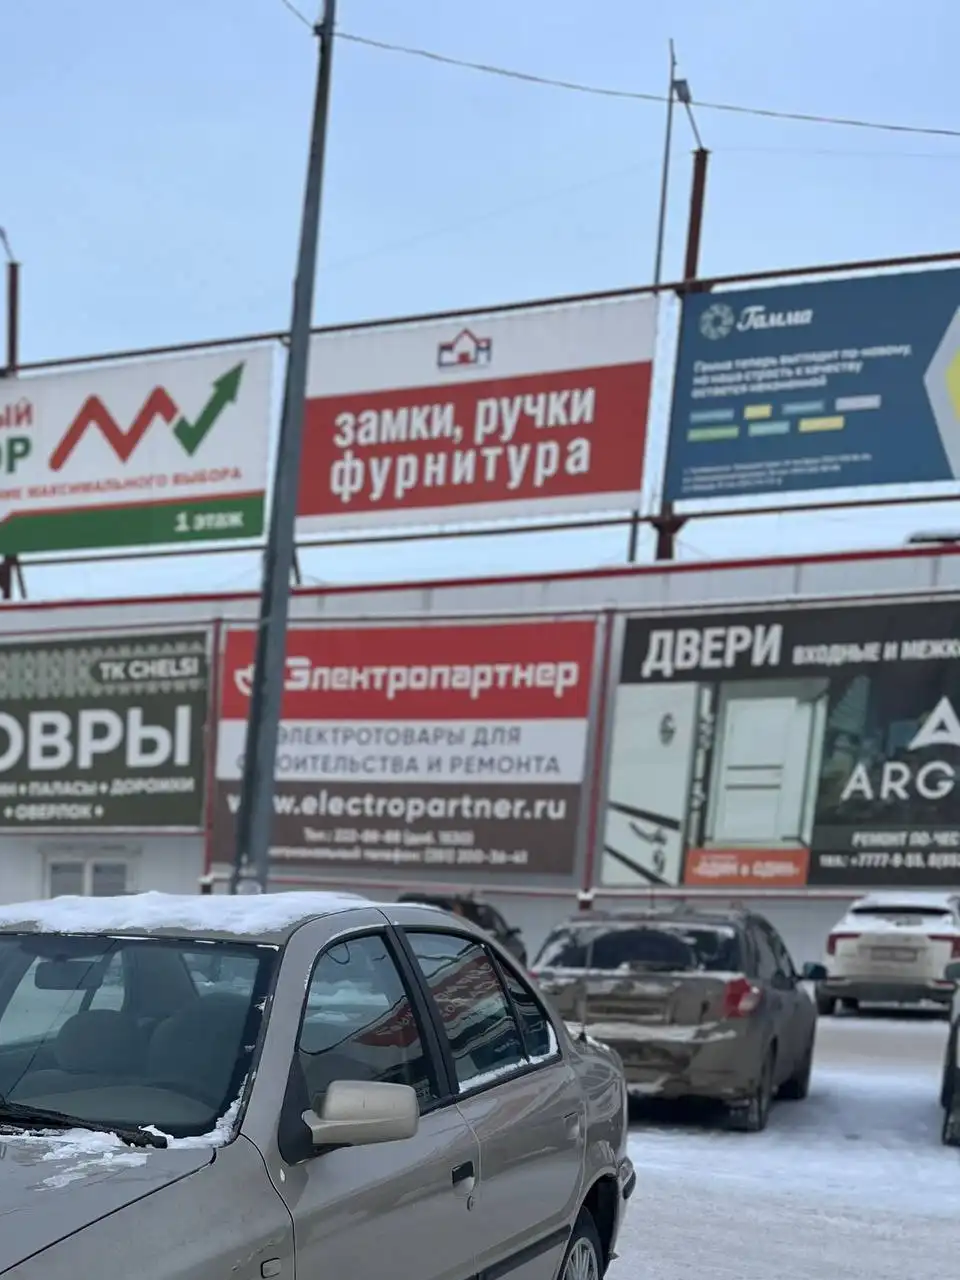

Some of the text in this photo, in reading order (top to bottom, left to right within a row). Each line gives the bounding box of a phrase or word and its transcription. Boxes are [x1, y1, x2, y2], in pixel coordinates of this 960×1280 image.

[737, 305, 813, 332] Гамма
[333, 387, 596, 448] замки, ручки
[27, 473, 168, 499] МАКСИМАЛЬНОГО
[172, 466, 243, 487] ВЫБОРА
[330, 437, 592, 504] фурнитура
[174, 511, 190, 532] 1
[642, 623, 783, 678] ДВЕРИ
[128, 656, 200, 680] CHELSI
[471, 725, 521, 749] ДЛЯ
[236, 753, 561, 775] СОИТЕЛЬСТВА И РЕМОНТА
